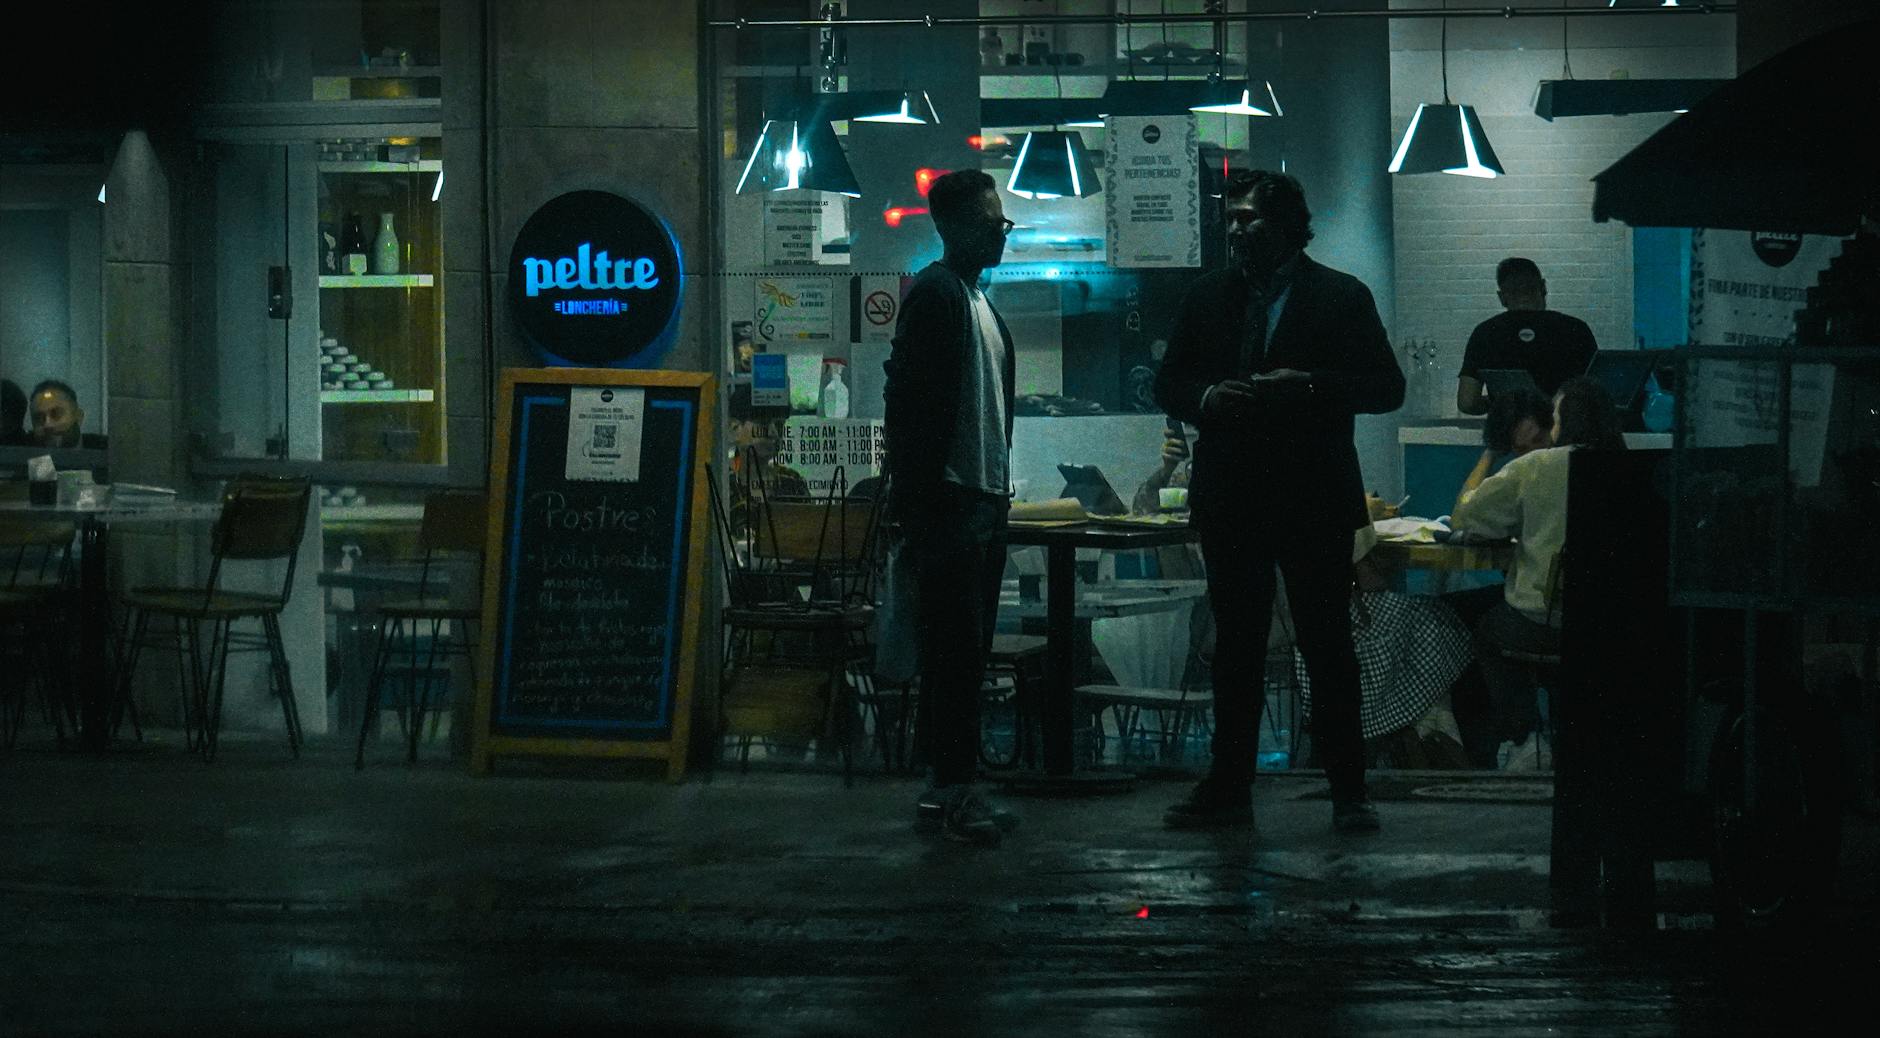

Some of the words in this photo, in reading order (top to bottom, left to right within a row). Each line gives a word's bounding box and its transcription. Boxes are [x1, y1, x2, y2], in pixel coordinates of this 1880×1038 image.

[523, 242, 660, 297] peltre
[800, 426, 820, 438] 7:00
[822, 426, 836, 438] AM
[847, 426, 872, 438] 11:00
[800, 440, 821, 452] 8:00
[823, 440, 837, 452] AM
[847, 440, 872, 452] 11:00
[800, 453, 821, 465] 8:00
[823, 453, 837, 465] AM
[848, 453, 872, 465] 10:00
